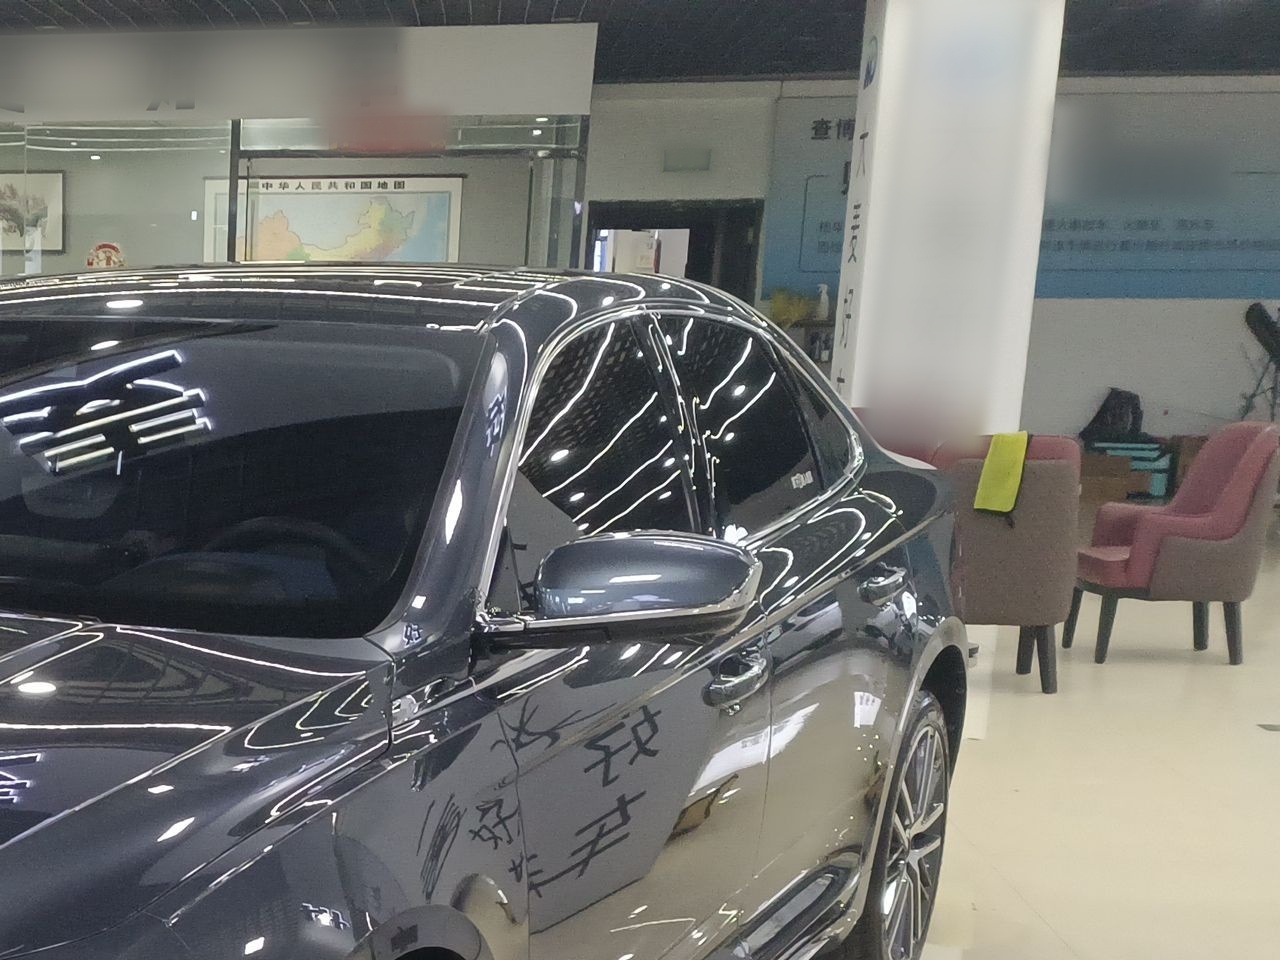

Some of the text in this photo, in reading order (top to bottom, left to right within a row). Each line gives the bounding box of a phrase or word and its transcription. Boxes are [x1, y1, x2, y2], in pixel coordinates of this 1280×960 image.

[261, 181, 406, 191] 中华人民共和国地图
